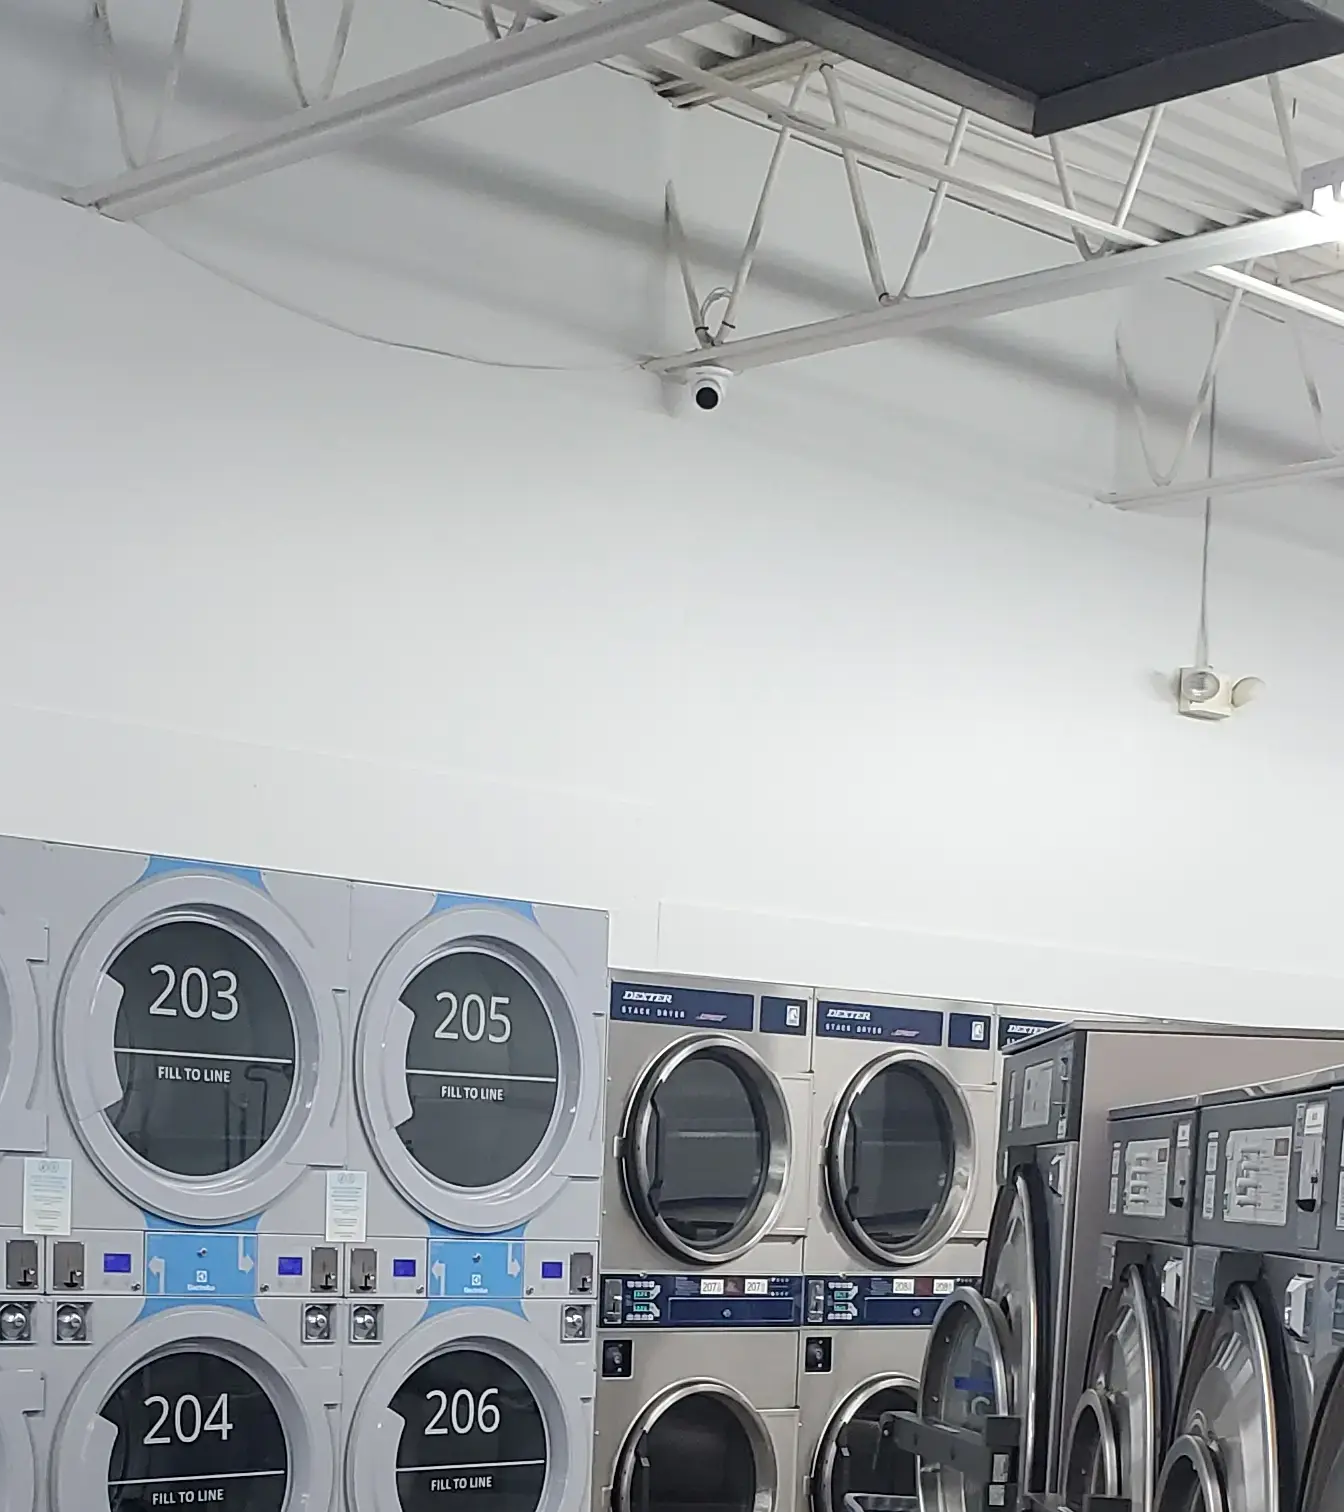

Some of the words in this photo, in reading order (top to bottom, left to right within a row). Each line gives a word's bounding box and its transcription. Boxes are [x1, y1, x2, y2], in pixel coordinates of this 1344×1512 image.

[149, 964, 239, 1021] 203
[622, 990, 673, 1004] DEXTER
[434, 991, 512, 1044] 205
[826, 1008, 871, 1021] DEXTER
[158, 1066, 182, 1080] FILL
[183, 1067, 201, 1081] TO
[203, 1069, 231, 1083] LINE
[441, 1085, 463, 1099] FILL
[463, 1086, 479, 1100] TO
[480, 1087, 505, 1101] LINE
[142, 1392, 234, 1446] 204
[423, 1387, 501, 1436] 206
[431, 1478, 452, 1491] FILL
[453, 1477, 468, 1490] TO
[469, 1476, 493, 1489] LINE
[152, 1491, 176, 1505] FILL
[177, 1490, 195, 1504] TO
[197, 1488, 225, 1502] LINE
